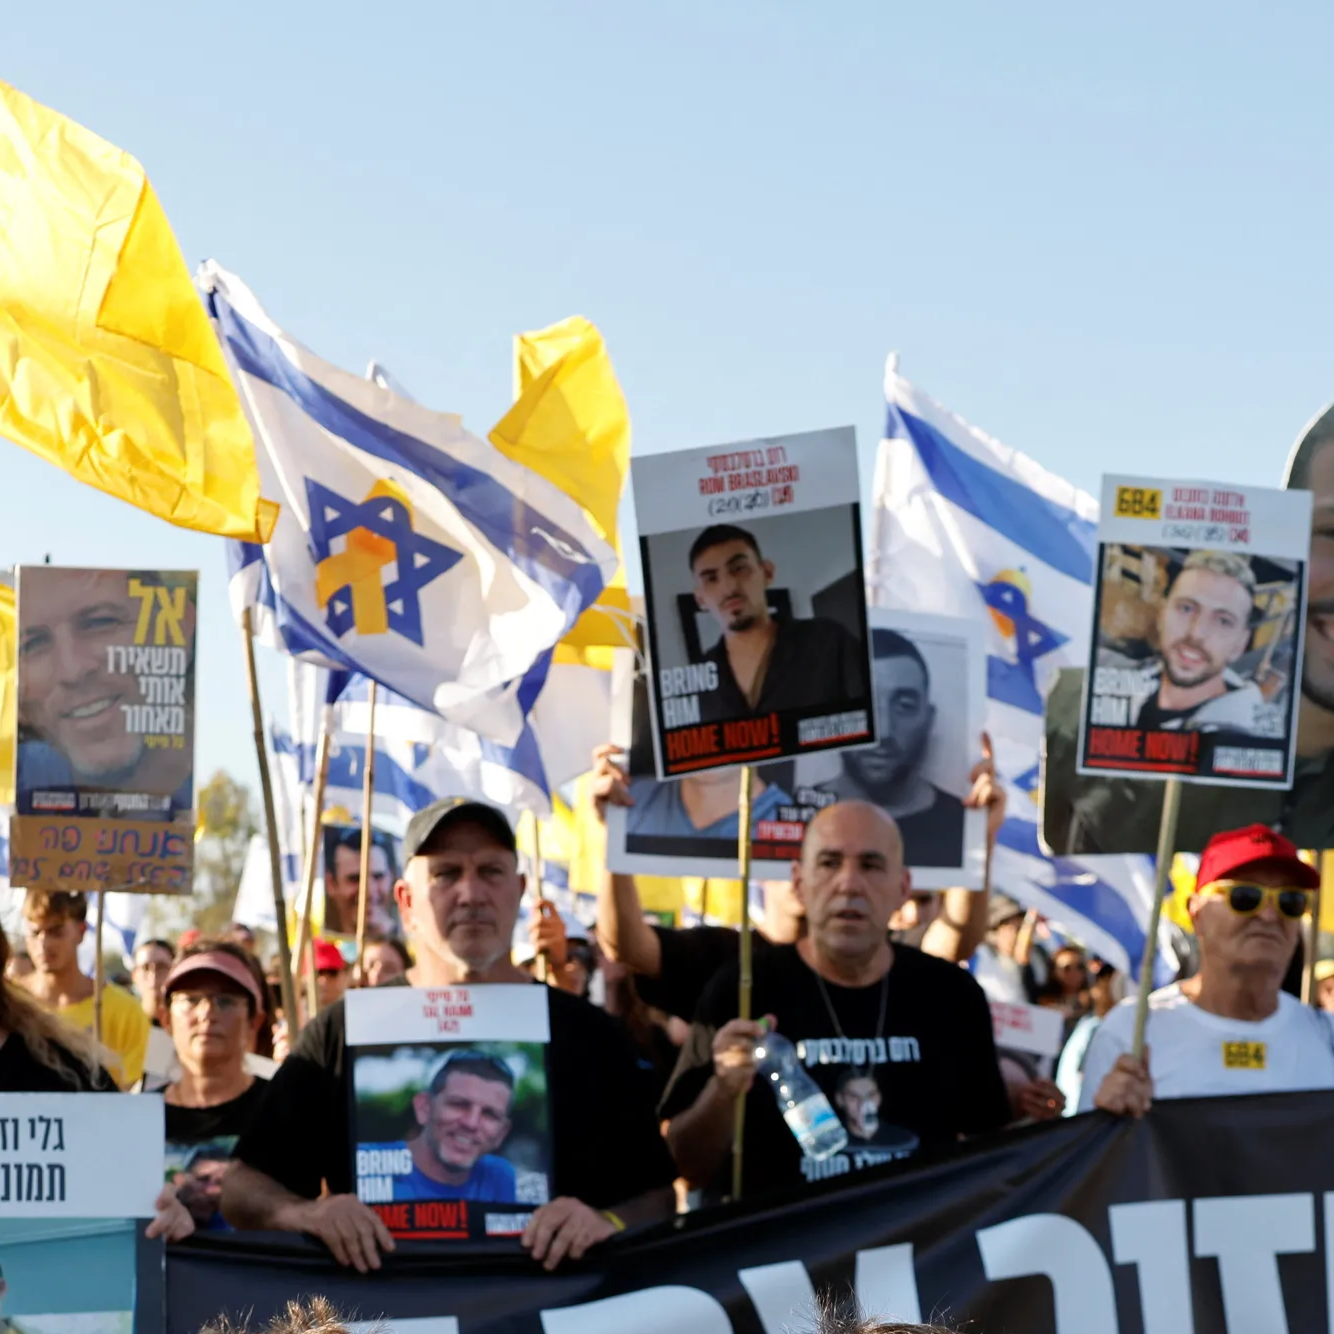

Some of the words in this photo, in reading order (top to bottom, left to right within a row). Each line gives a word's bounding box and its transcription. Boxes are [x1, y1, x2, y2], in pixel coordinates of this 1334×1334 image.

[128, 578, 187, 646] אל
[106, 646, 186, 674] תשאירו
[138, 676, 186, 705] אותי
[660, 662, 719, 698] BRING
[120, 704, 184, 734] מאחור
[661, 695, 701, 729] HIM
[666, 725, 719, 761] HOME
[723, 713, 781, 750] NOW!
[28, 1116, 65, 1151] גלי
[357, 1149, 413, 1175] BRING
[357, 1176, 394, 1203] HIM
[414, 1200, 468, 1228] NOW!
